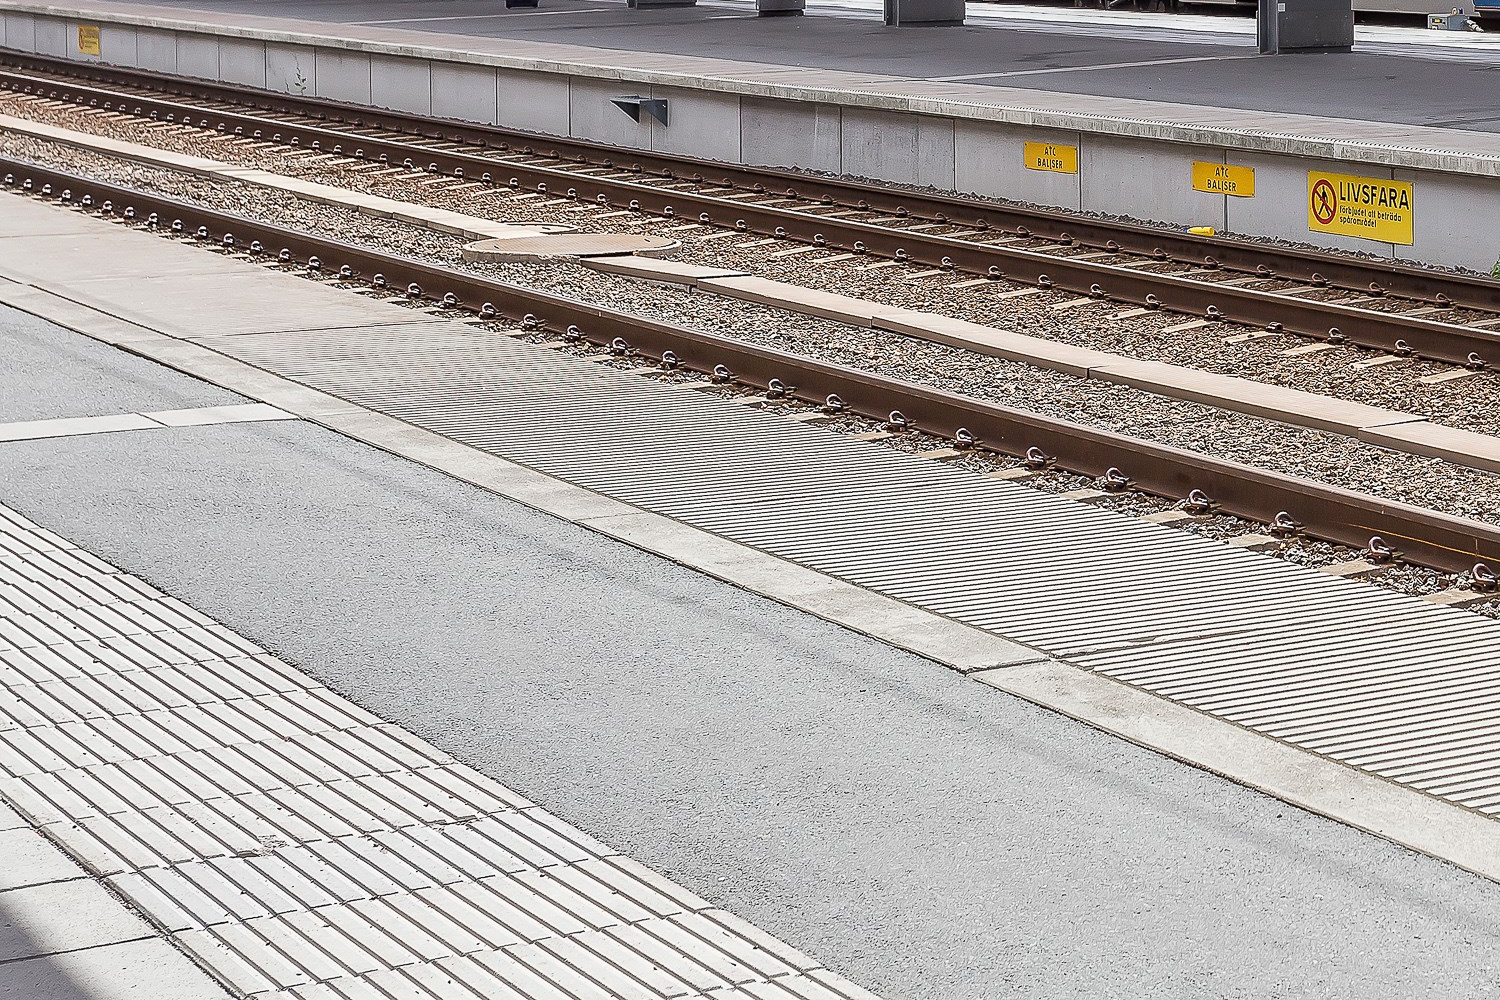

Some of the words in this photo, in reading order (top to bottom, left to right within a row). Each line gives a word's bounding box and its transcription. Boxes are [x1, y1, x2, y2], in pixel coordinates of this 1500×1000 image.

[1044, 145, 1056, 157] ATC
[1037, 157, 1063, 169] BALISER
[1215, 165, 1229, 178] ATC
[1207, 179, 1237, 192] BALISER
[1339, 181, 1410, 210] LIVSFARA
[1339, 204, 1367, 219] förbjudet
[1367, 210, 1376, 218] att
[1377, 210, 1402, 222] beträda
[1339, 216, 1377, 228] spårområdet
